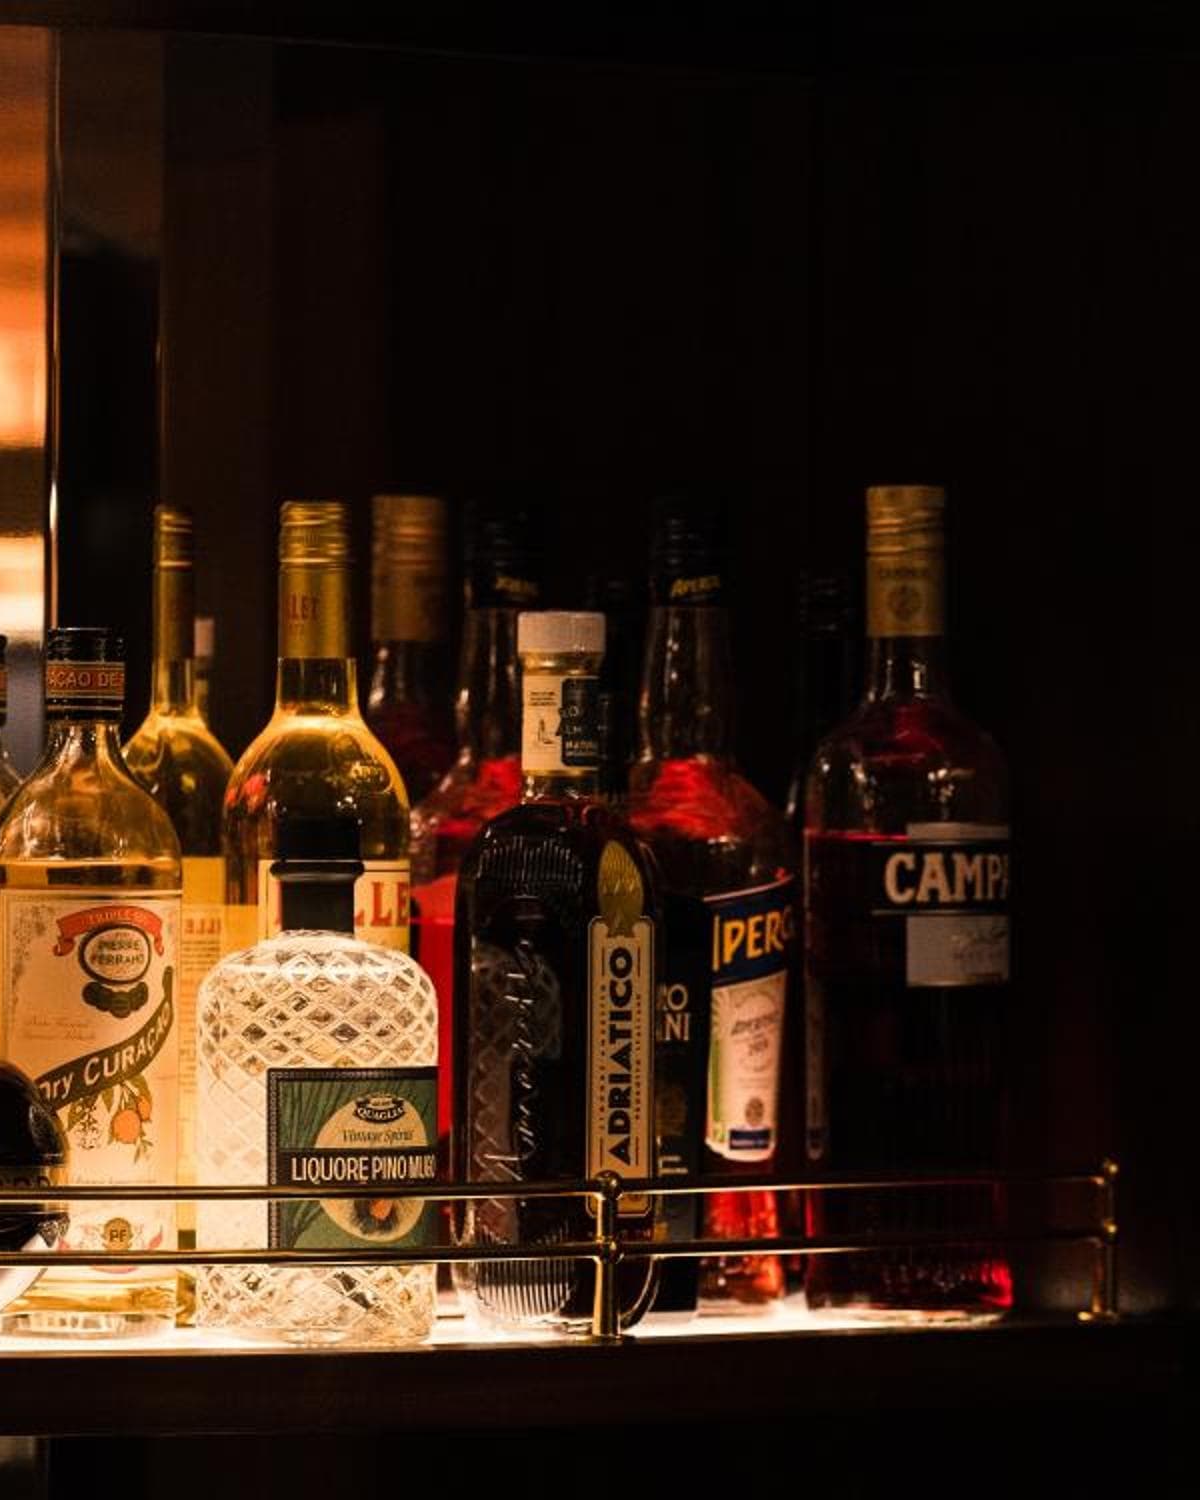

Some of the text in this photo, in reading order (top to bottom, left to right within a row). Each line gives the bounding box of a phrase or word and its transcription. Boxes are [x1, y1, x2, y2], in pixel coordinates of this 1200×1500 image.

[607, 946, 634, 1167] ADRIATICO
[291, 1155, 370, 1185] LIQUORE
[371, 1154, 408, 1180] PINO
